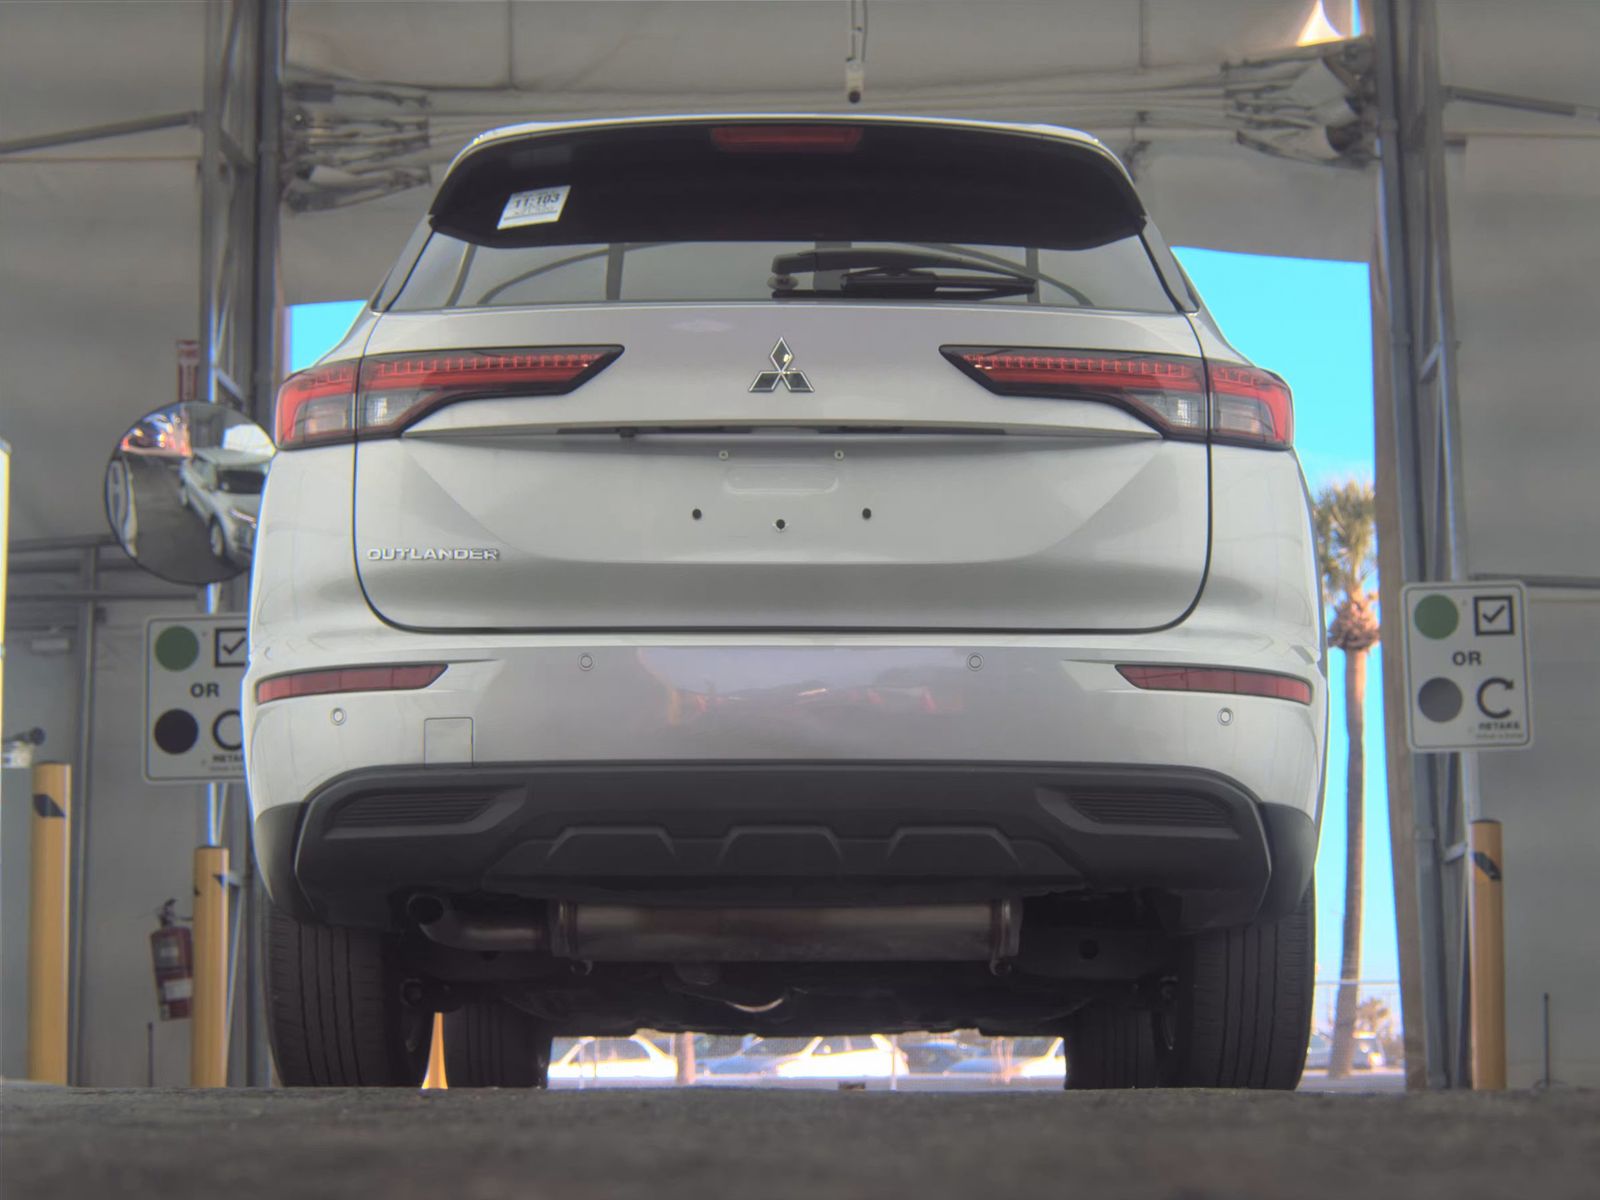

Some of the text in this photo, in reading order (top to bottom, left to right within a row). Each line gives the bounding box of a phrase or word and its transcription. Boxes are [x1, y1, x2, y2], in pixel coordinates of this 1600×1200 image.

[367, 548, 499, 560] OUTLANDER
[1452, 651, 1482, 666] OR
[190, 682, 220, 698] OR
